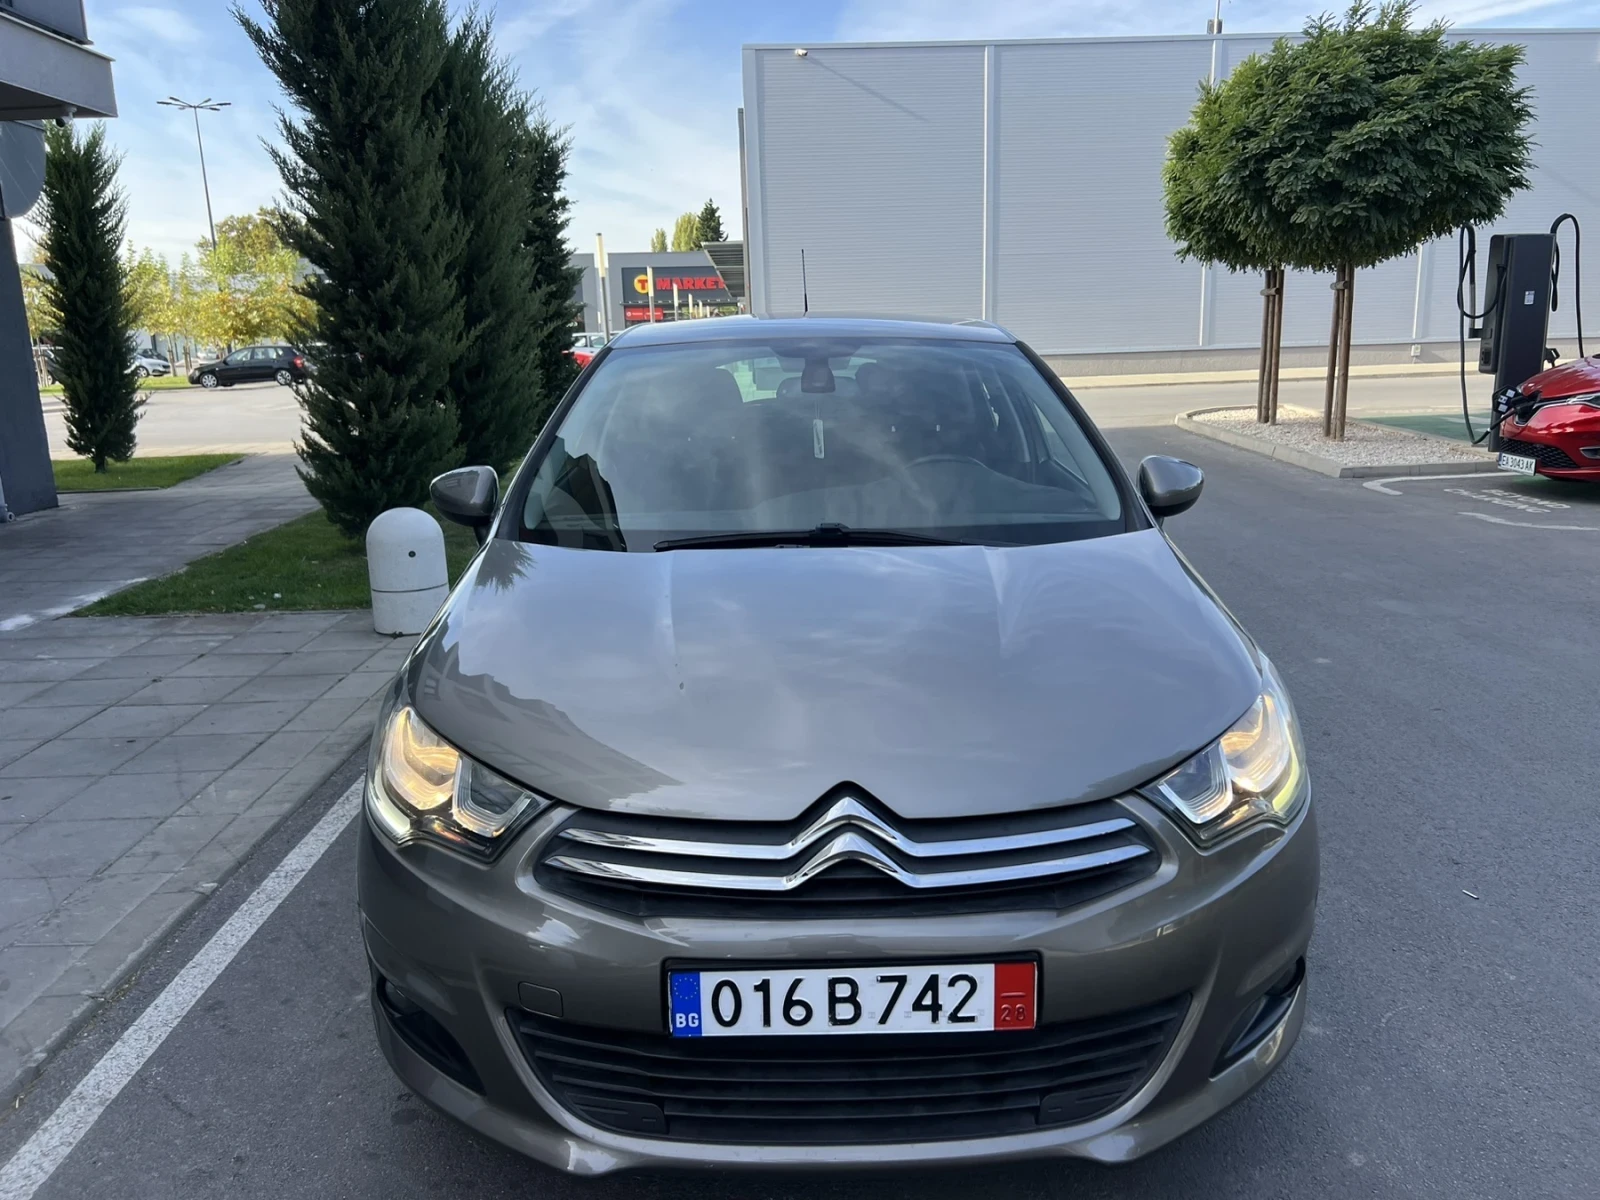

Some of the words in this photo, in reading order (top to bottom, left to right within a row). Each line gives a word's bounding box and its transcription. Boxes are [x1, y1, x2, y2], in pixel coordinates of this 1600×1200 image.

[637, 279, 648, 290] T
[675, 1012, 699, 1029] BG
[1001, 1003, 1026, 1021] 28
